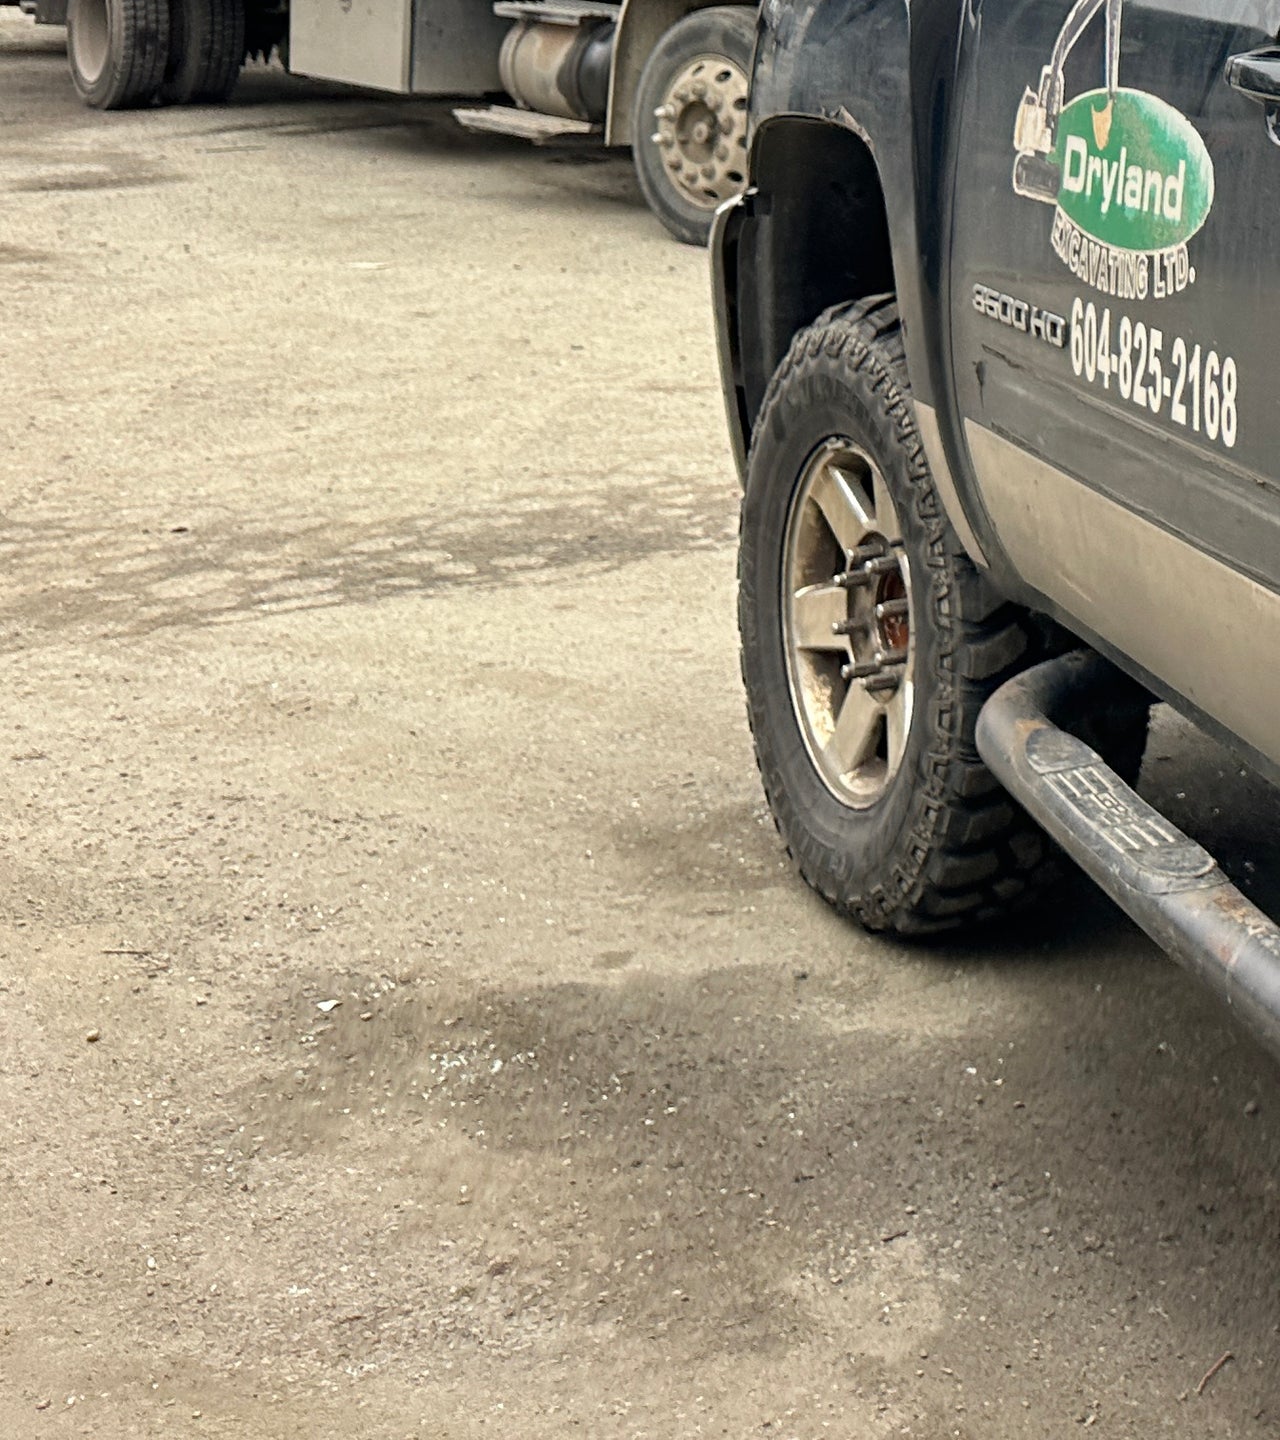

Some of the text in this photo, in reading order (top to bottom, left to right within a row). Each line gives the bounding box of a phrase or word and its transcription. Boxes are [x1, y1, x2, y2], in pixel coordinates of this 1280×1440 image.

[1063, 134, 1186, 221] Dryland
[1051, 209, 1196, 300] EXCAVATING LTD.
[972, 283, 1066, 348] 3500 HD
[1070, 297, 1237, 448] 604-825-2168
